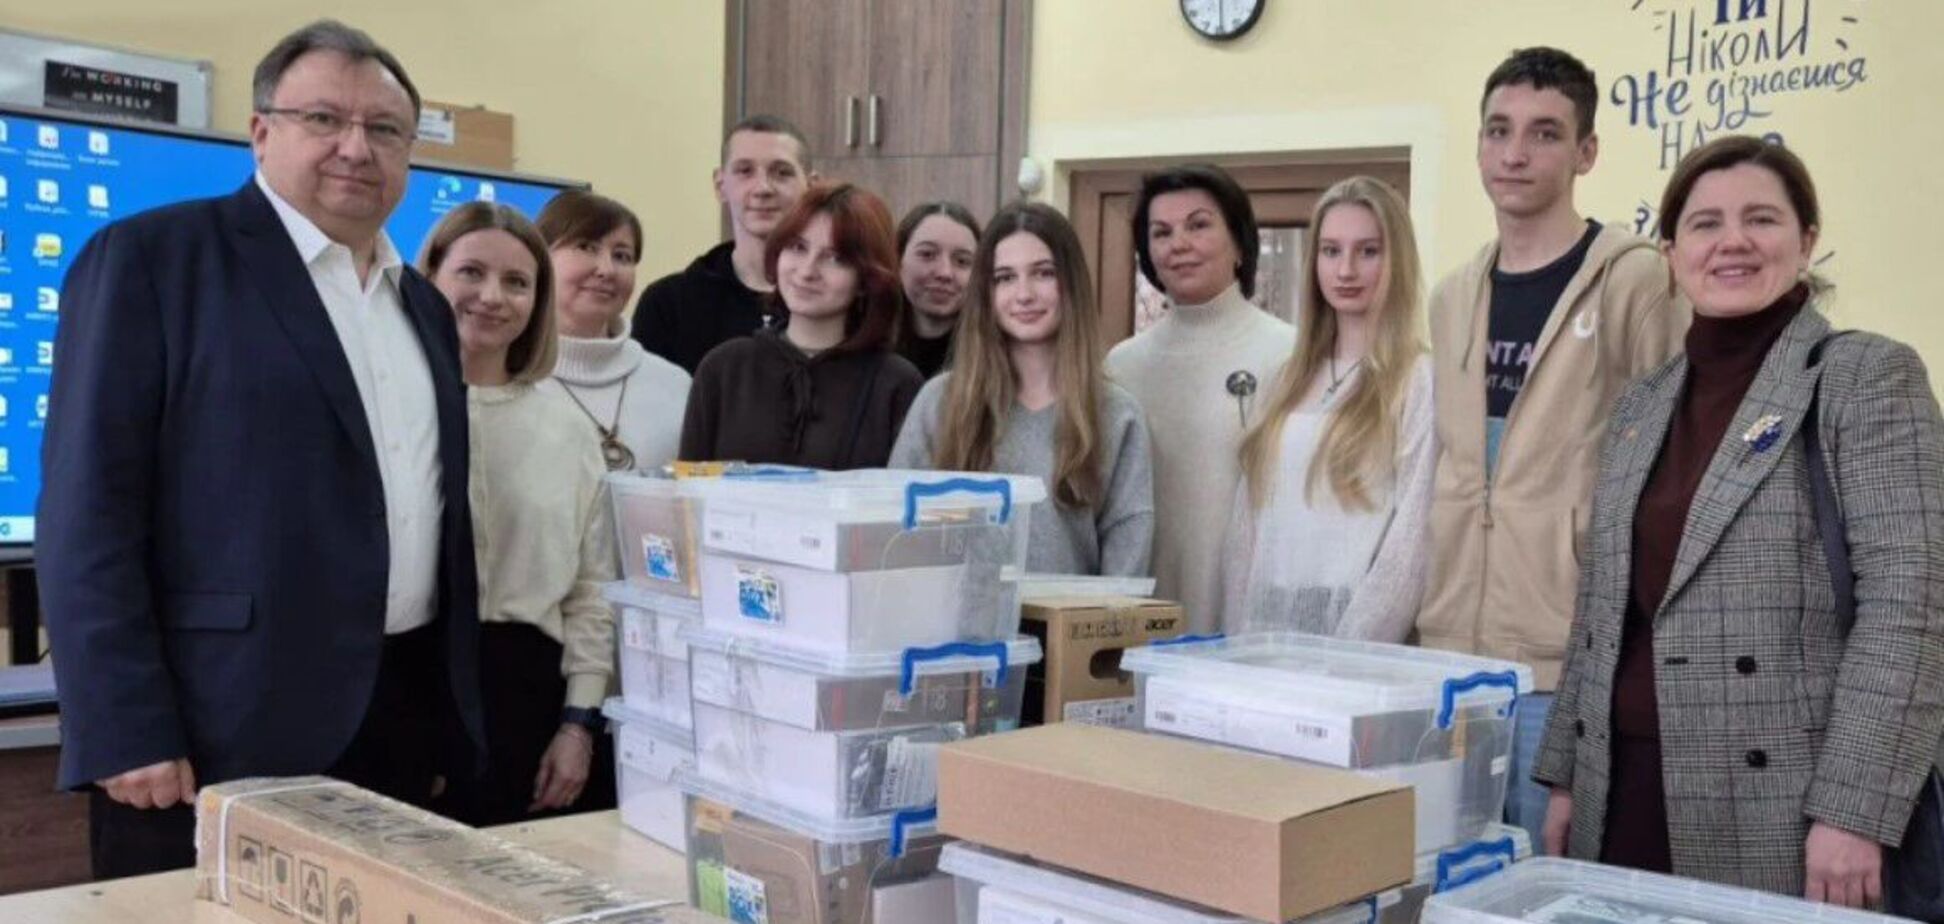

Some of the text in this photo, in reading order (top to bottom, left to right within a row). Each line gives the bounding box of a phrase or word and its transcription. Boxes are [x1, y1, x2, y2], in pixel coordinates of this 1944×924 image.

[87, 71, 163, 92] WORKING
[92, 92, 153, 110] MYSELF
[1145, 618, 1178, 632] acer
